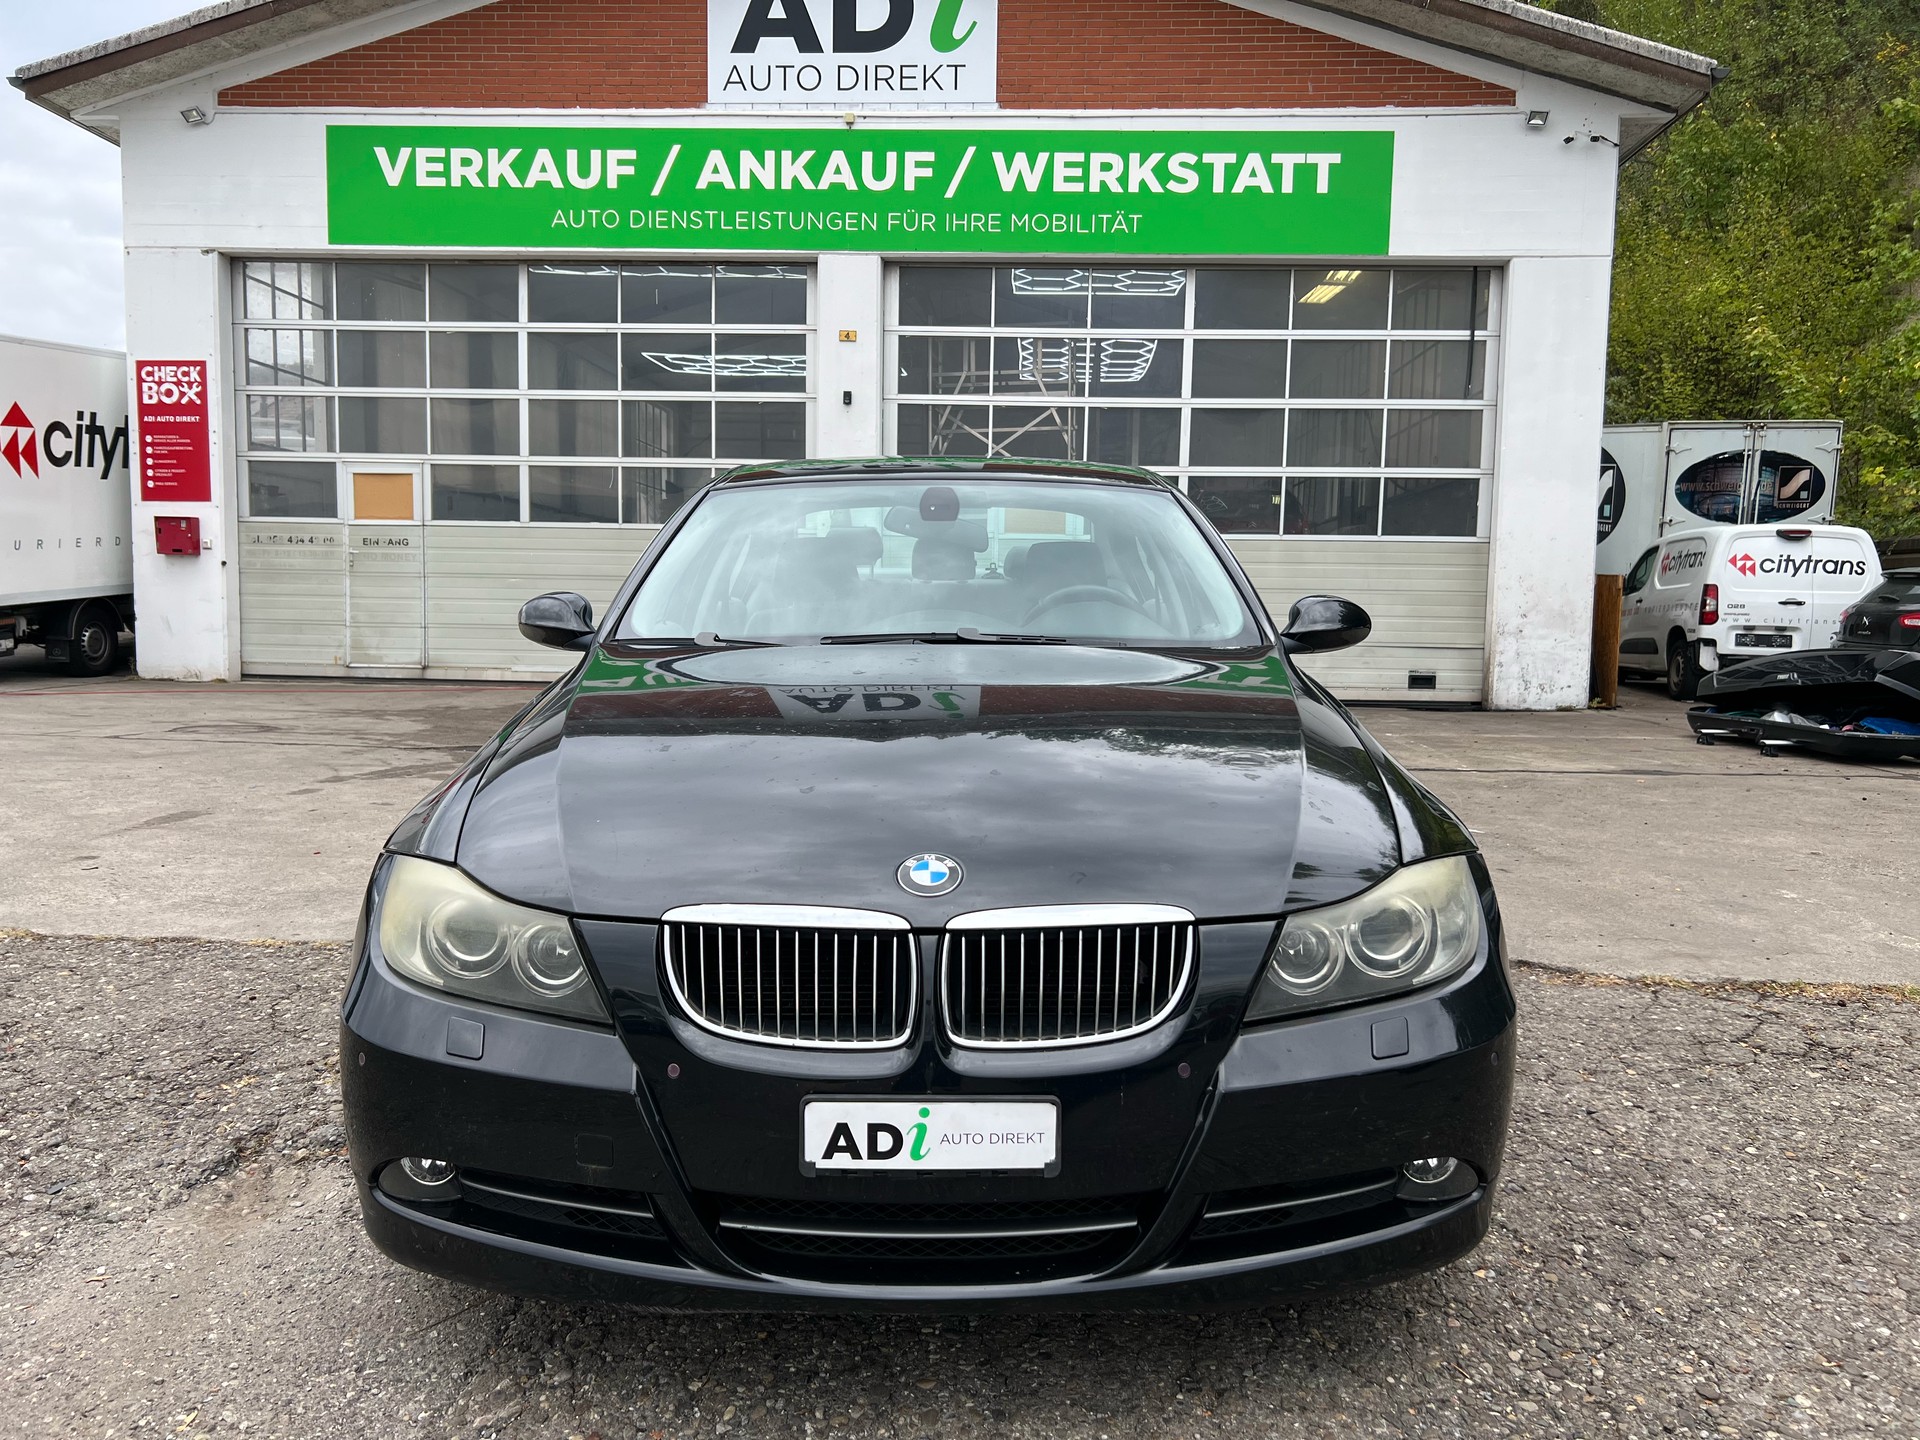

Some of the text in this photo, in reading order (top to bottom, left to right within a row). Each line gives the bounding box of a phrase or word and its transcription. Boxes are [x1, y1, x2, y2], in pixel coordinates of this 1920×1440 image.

[723, 64, 967, 92] AUTO DIREKT
[373, 144, 1343, 199] VERKAUF / ANKAUF / WERKSTATT
[551, 209, 1143, 234] AUTO DIENSTLEISTUNGEN FÜR IHRE MOBILITÄT
[844, 332, 851, 340] 4
[141, 366, 202, 382] CHECK
[362, 538, 409, 547] EINANG
[1759, 554, 1867, 578] citytrans
[904, 853, 956, 868] BMW
[821, 1107, 1045, 1161] ADi AUTO DIREKT
